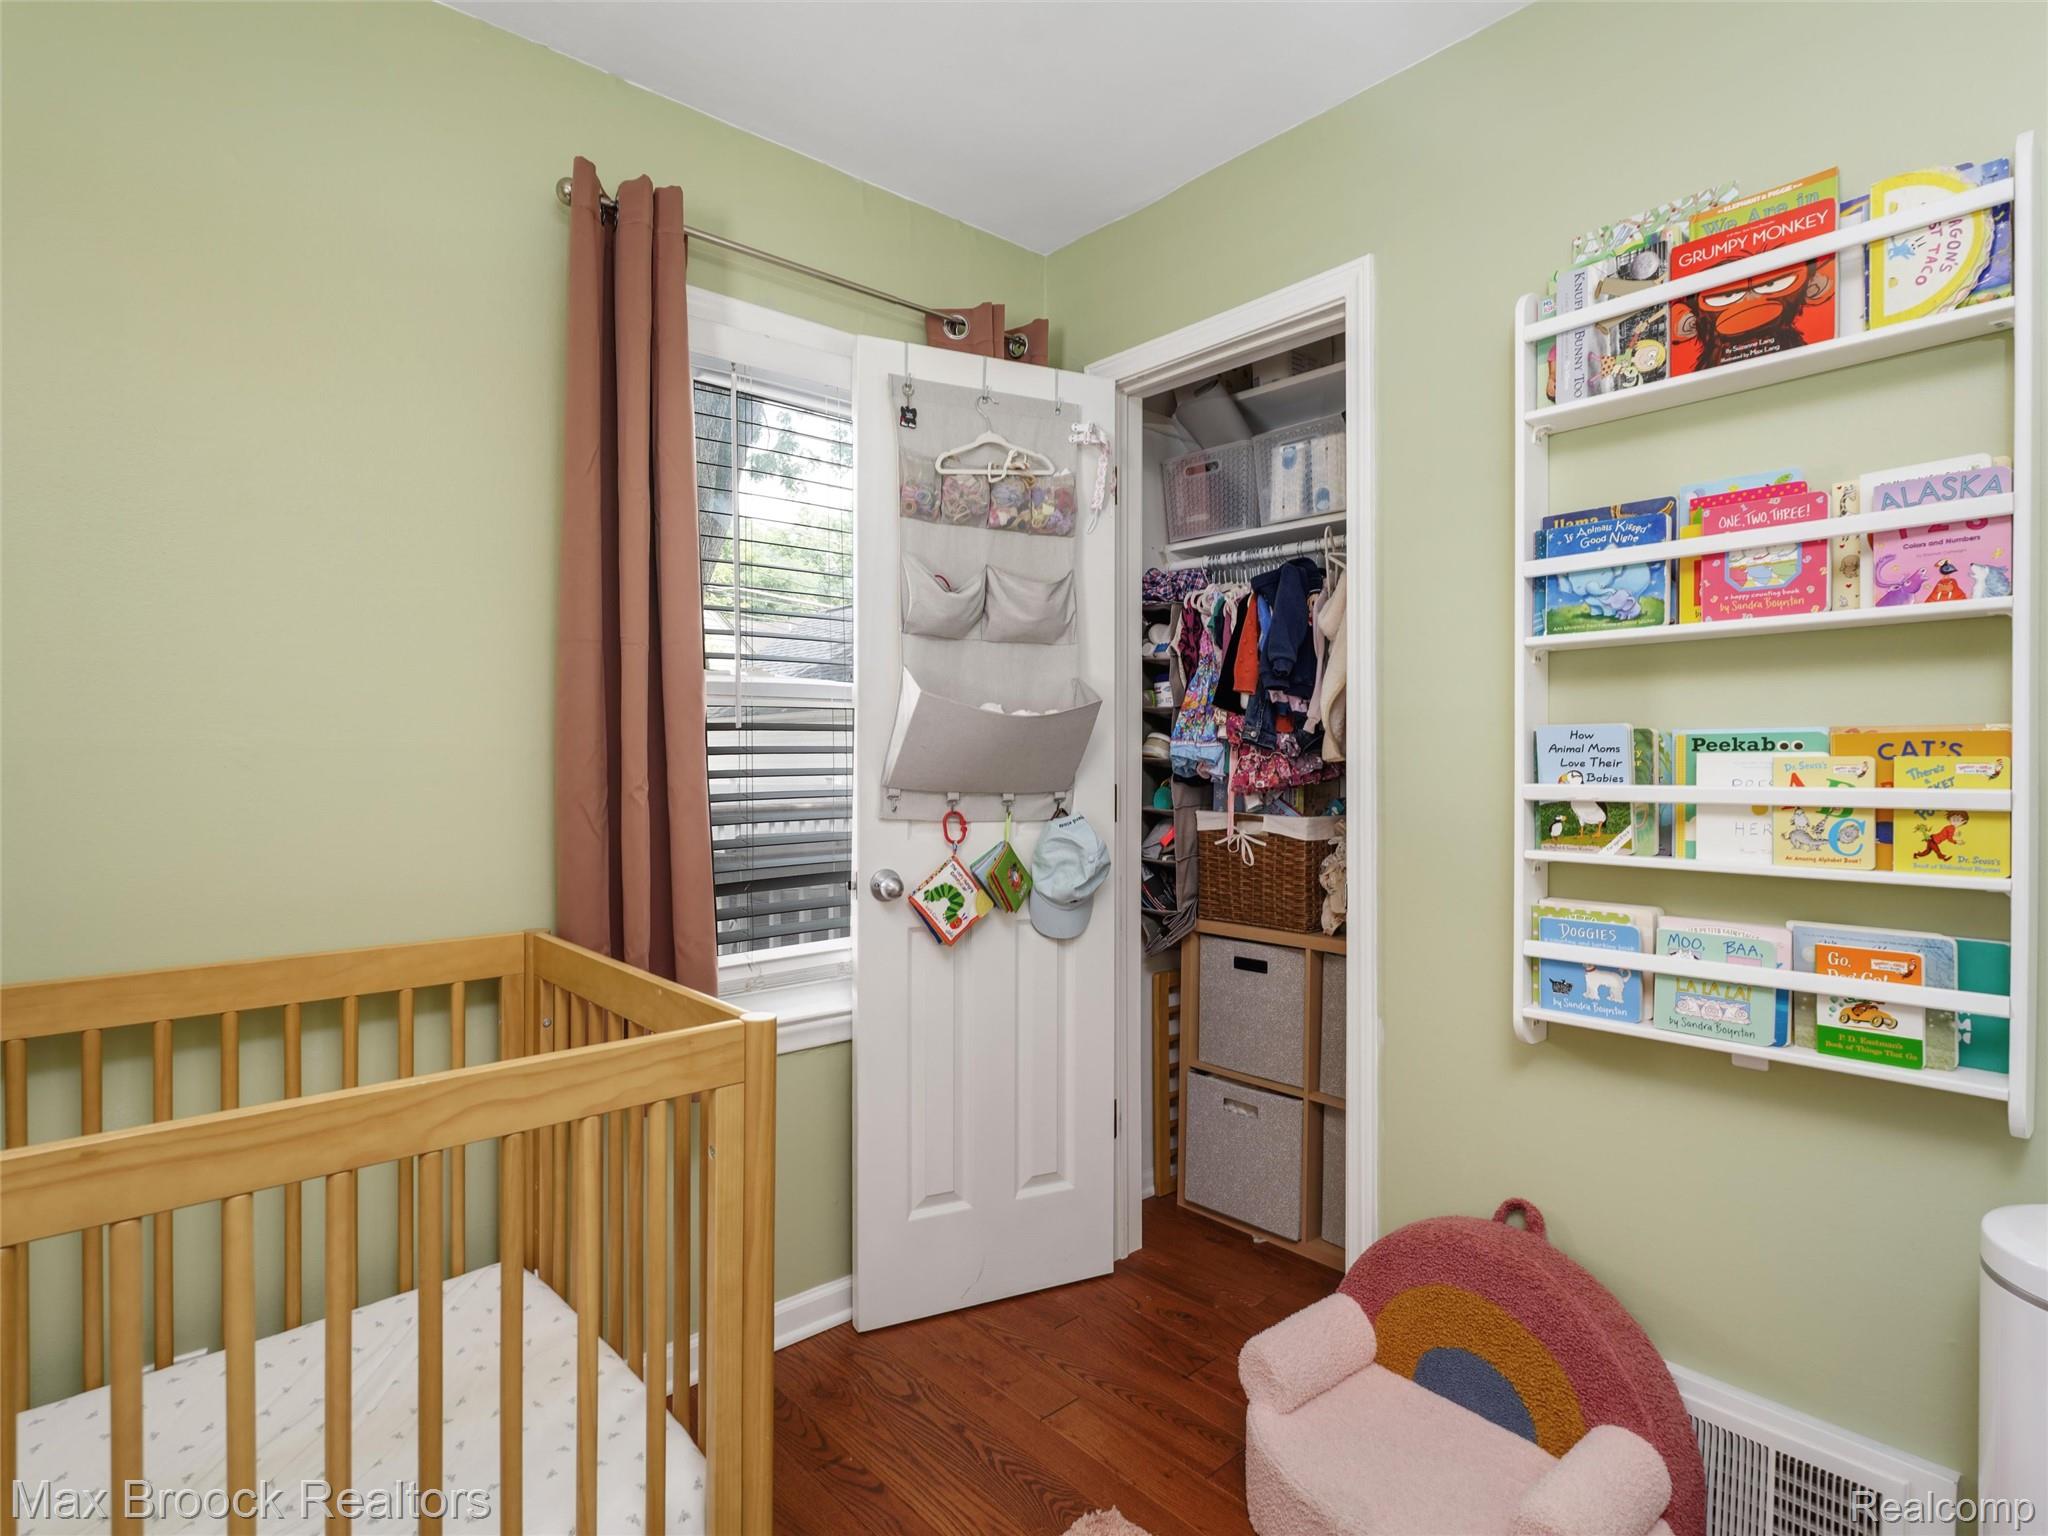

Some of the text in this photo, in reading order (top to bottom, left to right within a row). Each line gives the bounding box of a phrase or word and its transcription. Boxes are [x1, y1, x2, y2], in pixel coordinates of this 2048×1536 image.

[1678, 235, 1748, 267] GRUMPY
[1752, 209, 1829, 246] MONKEY
[1915, 243, 1941, 286] TACO
[1880, 474, 2004, 512] ALASKA
[1770, 504, 1811, 521] THREE!
[1580, 534, 1607, 549] Good
[1903, 535, 1981, 550] Colors and Numbers
[1720, 596, 1805, 614] by Sandra Boynton
[1569, 730, 1595, 740] How
[1548, 743, 1621, 753] Animal Moms
[1877, 740, 1964, 761] CAT'S
[1560, 758, 1586, 768] Love
[1590, 756, 1623, 768] Their
[1586, 773, 1625, 783] Babies
[1906, 764, 1946, 780] There's
[1735, 822, 1773, 836] HER
[1558, 923, 1617, 942] DOGGIES
[1667, 933, 1764, 958] MOO, BAA,
[1827, 951, 1851, 968] Go,
[1563, 996, 1591, 1010] Sandra
[1593, 1002, 1628, 1016] Boynton
[1669, 1016, 1756, 1039] by Sandra Boynton
[1825, 1040, 1843, 1050] Book
[1845, 1042, 1854, 1051] of
[1856, 1044, 1884, 1057] Things
[1884, 1047, 1904, 1059] That
[1860, 1036, 1904, 1050] Eastman's
